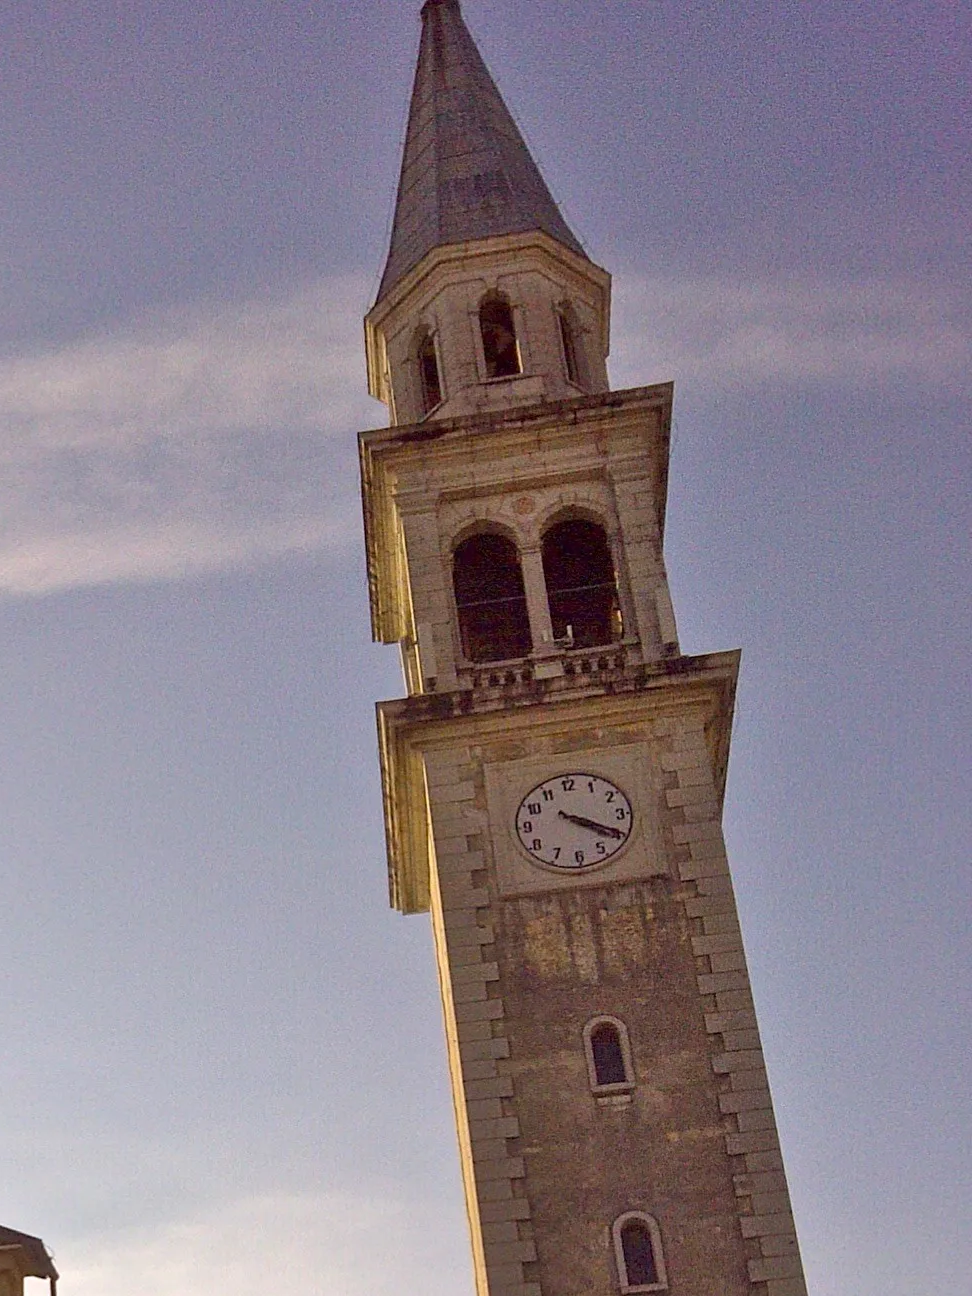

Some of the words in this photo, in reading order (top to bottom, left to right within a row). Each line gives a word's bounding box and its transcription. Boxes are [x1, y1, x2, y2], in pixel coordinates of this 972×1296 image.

[562, 780, 575, 791] 12
[588, 782, 594, 793] 1
[542, 790, 554, 801] 11
[605, 791, 615, 803] 2
[528, 803, 541, 815] 10
[616, 808, 625, 820] 3
[523, 821, 532, 833] 9
[533, 838, 542, 851] 8
[596, 842, 605, 854] 5
[553, 847, 561, 860] 7
[575, 850, 584, 863] 6
